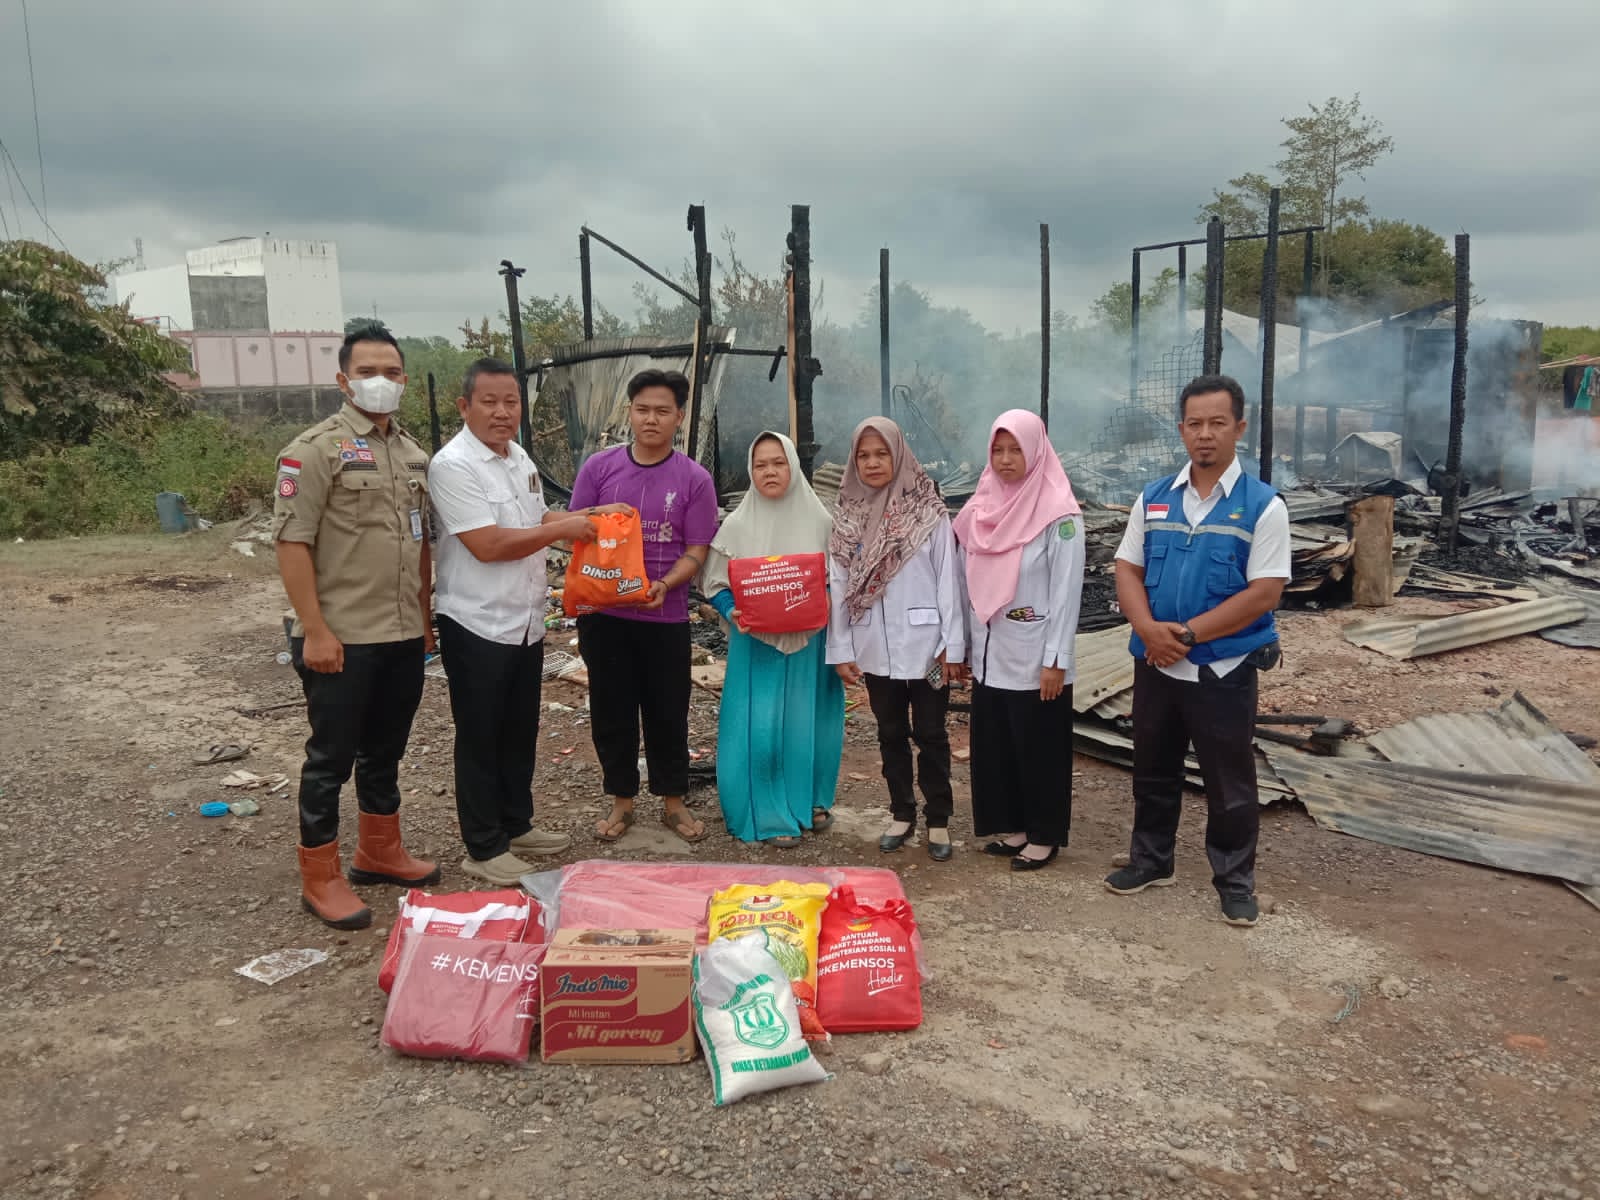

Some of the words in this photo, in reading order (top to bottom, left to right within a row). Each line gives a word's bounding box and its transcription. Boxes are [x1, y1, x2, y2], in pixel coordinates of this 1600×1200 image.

[743, 581, 804, 597] #KEMENSOS
[840, 931, 879, 942] BANTUAN
[829, 941, 851, 952] PAKET
[852, 937, 892, 946] SANDANG
[869, 945, 897, 954] SOSIAL
